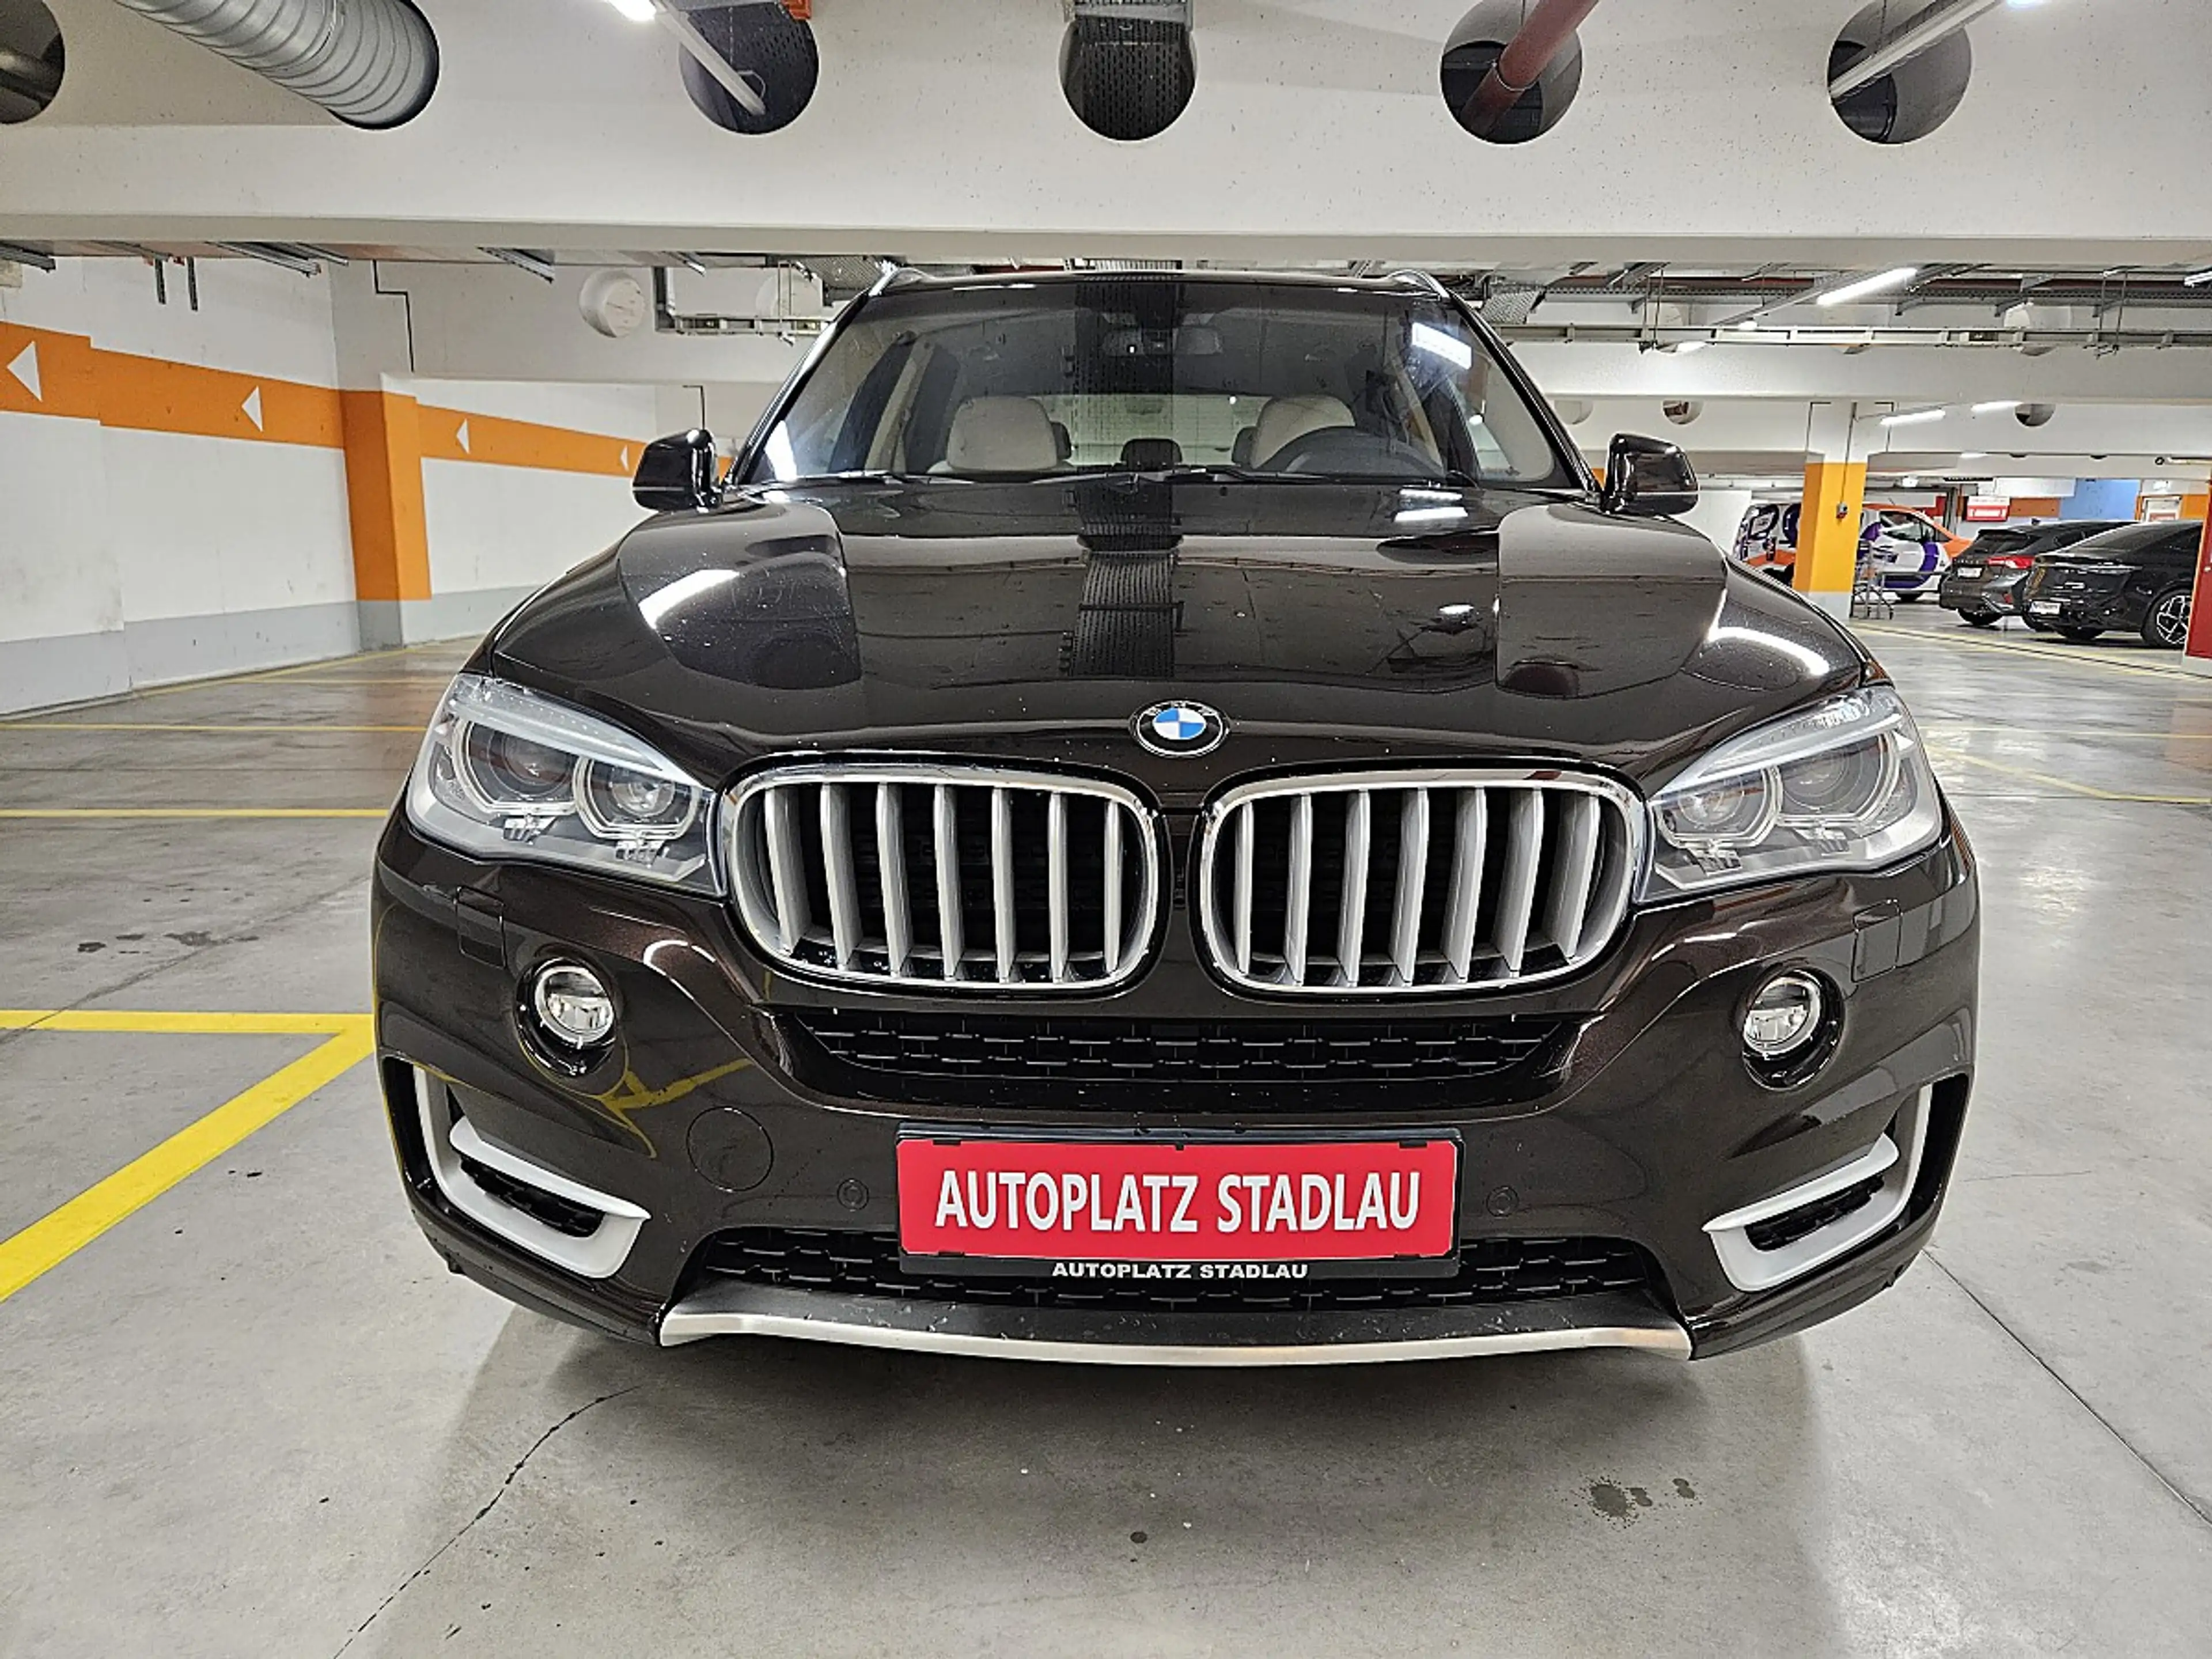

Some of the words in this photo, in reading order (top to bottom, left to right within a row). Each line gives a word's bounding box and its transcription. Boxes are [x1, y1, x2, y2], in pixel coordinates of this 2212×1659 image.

[935, 1170, 1198, 1232] AUTOPLATZ
[1218, 1172, 1420, 1232] STADLAU
[1052, 1262, 1191, 1279] AUTOPLATZ
[1200, 1264, 1308, 1279] STADLAU
